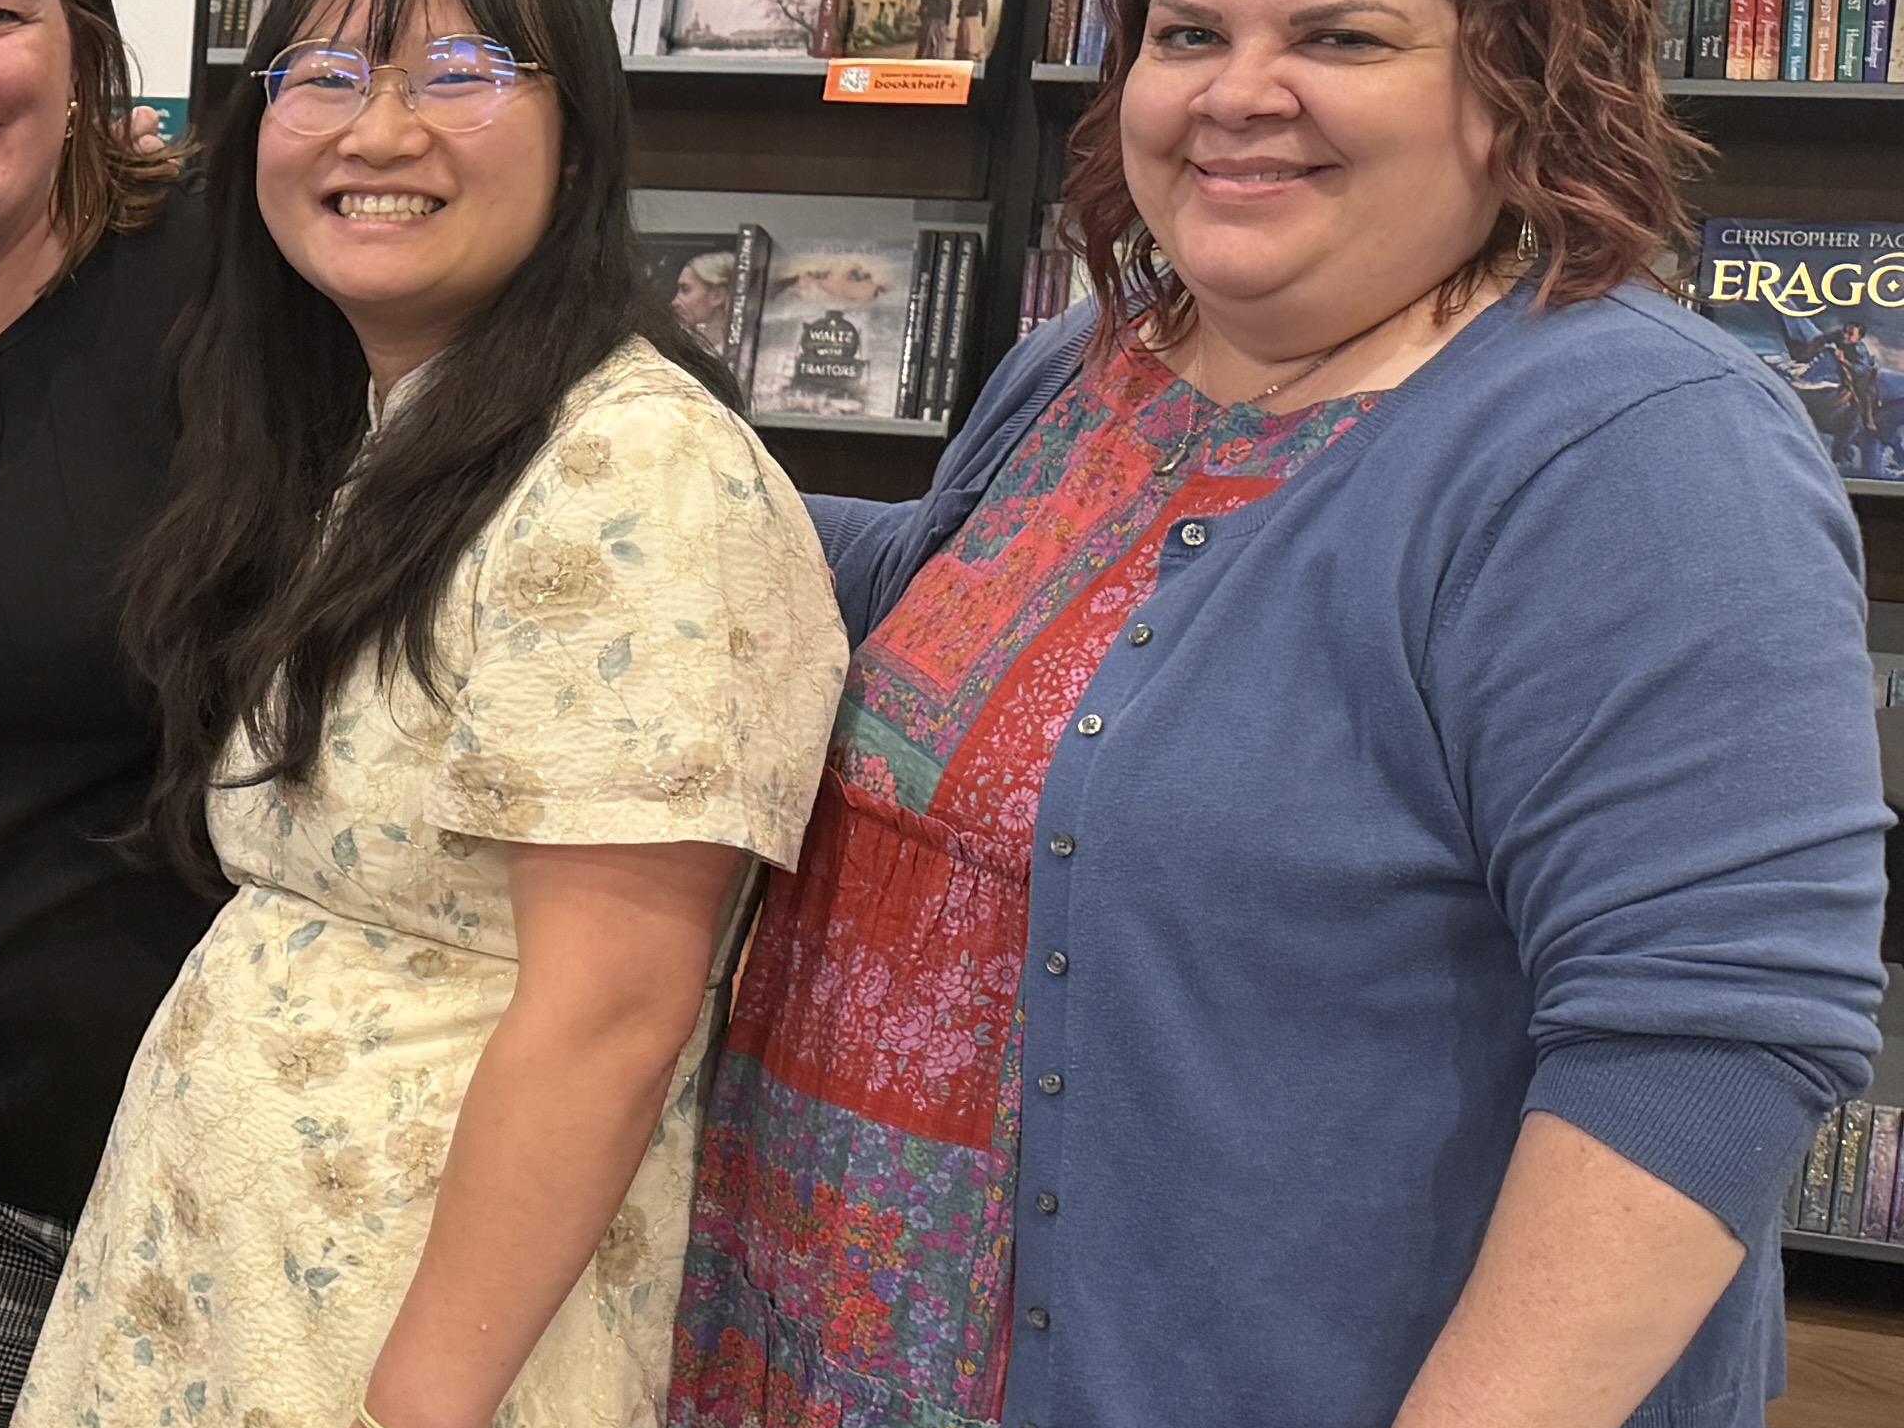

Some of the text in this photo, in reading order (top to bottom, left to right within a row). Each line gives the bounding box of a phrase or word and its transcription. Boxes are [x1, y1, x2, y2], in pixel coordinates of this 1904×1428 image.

[874, 80, 945, 91] bookshelf
[1721, 229, 1860, 247] CHRISTOPHER
[810, 330, 854, 342] WALTZ
[800, 363, 857, 378] TRAITORS
